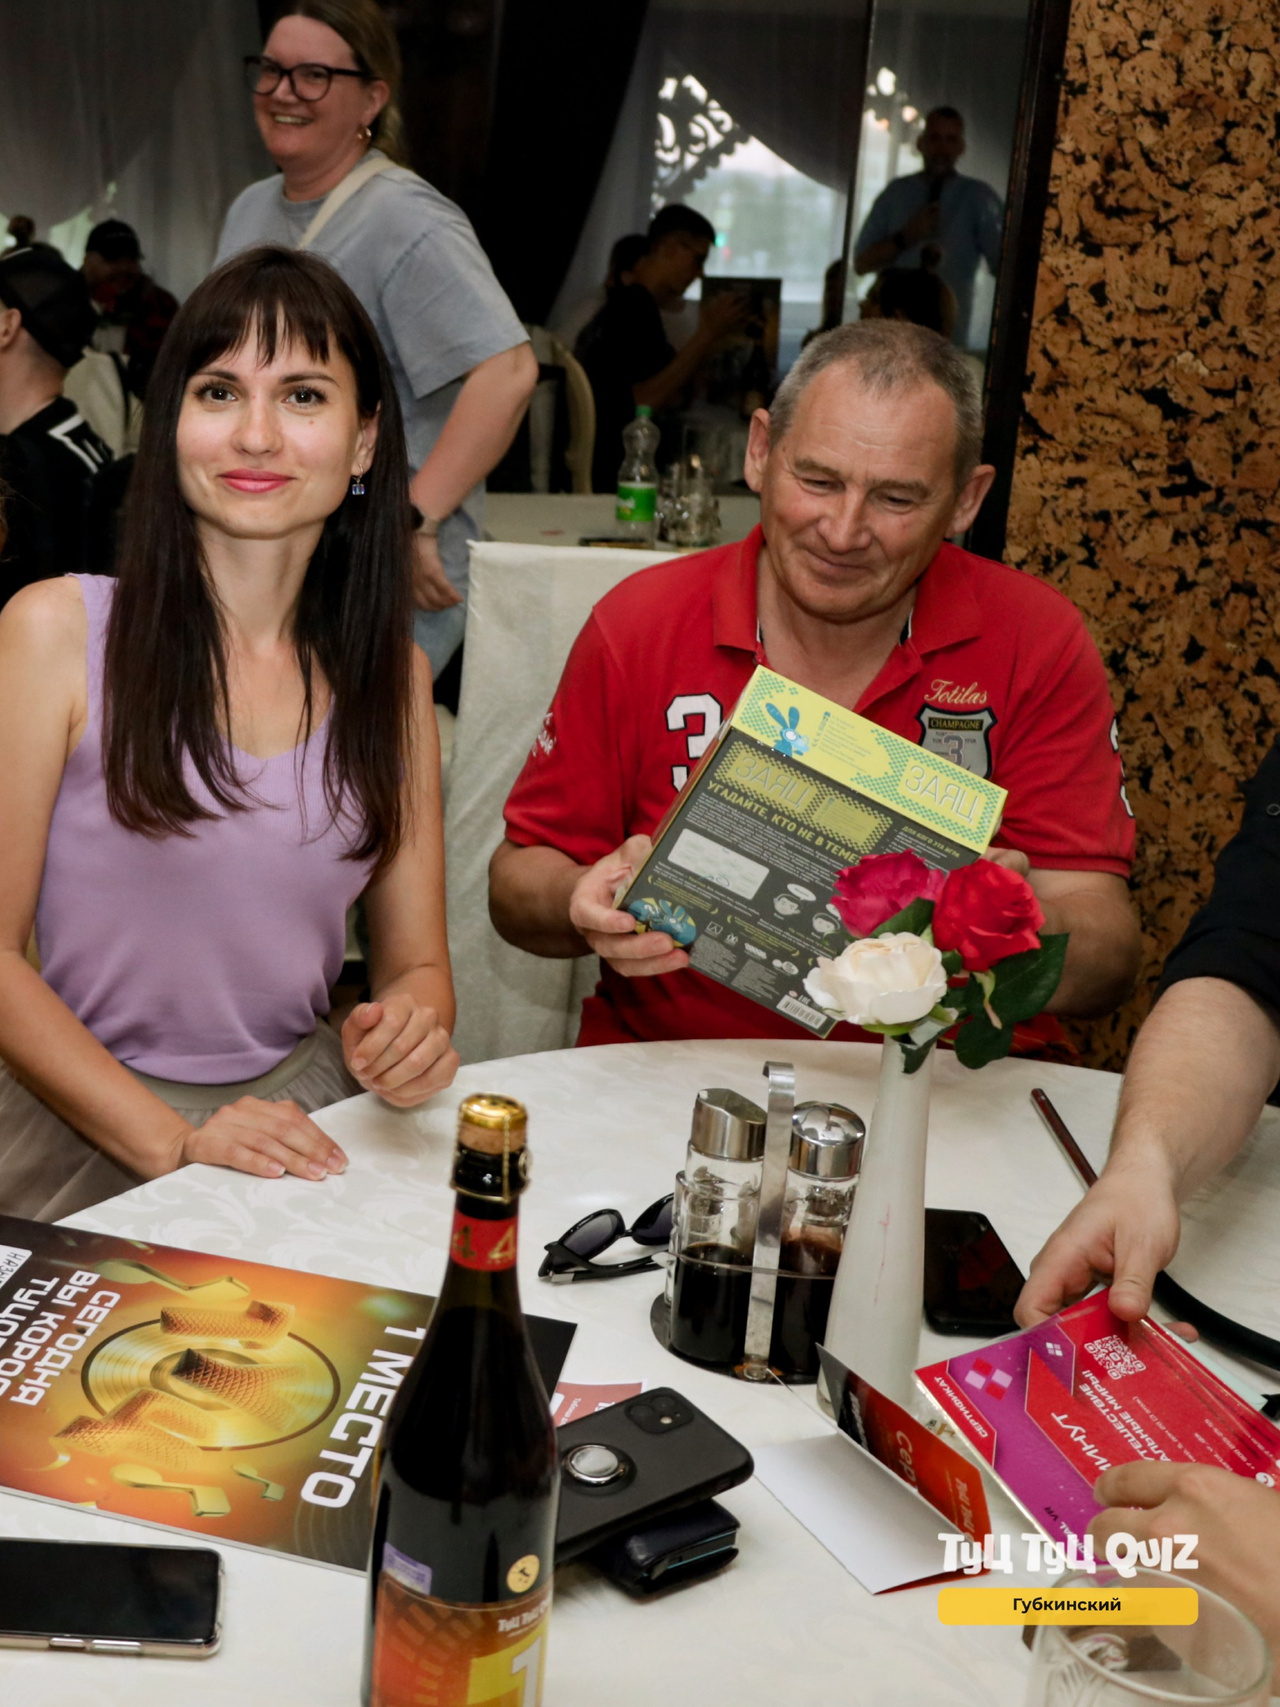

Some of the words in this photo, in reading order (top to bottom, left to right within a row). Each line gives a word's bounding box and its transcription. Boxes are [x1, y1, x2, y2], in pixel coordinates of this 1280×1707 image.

[923, 678, 987, 704] Totilas
[930, 718, 982, 730] CHAMPAGNE
[735, 756, 811, 809] ЗАЯЦ
[905, 764, 980, 824] ЗАЯЦ
[707, 780, 768, 820] УГАДАЙТЕ,
[771, 813, 798, 834] КТО
[797, 824, 815, 842] НЕ
[814, 835, 825, 847] В
[50, 1270, 101, 1307] ВЫ
[9, 1290, 122, 1406] СЕГОДНЯ
[384, 1326, 427, 1340] 1
[300, 1348, 415, 1508] МЕСТО
[934, 1376, 989, 1438] СЕРТИФИКАТ
[1079, 1383, 1155, 1461] ТЕШЕСТВИЕ
[1119, 1411, 1172, 1462] АЛЬНЫЕ
